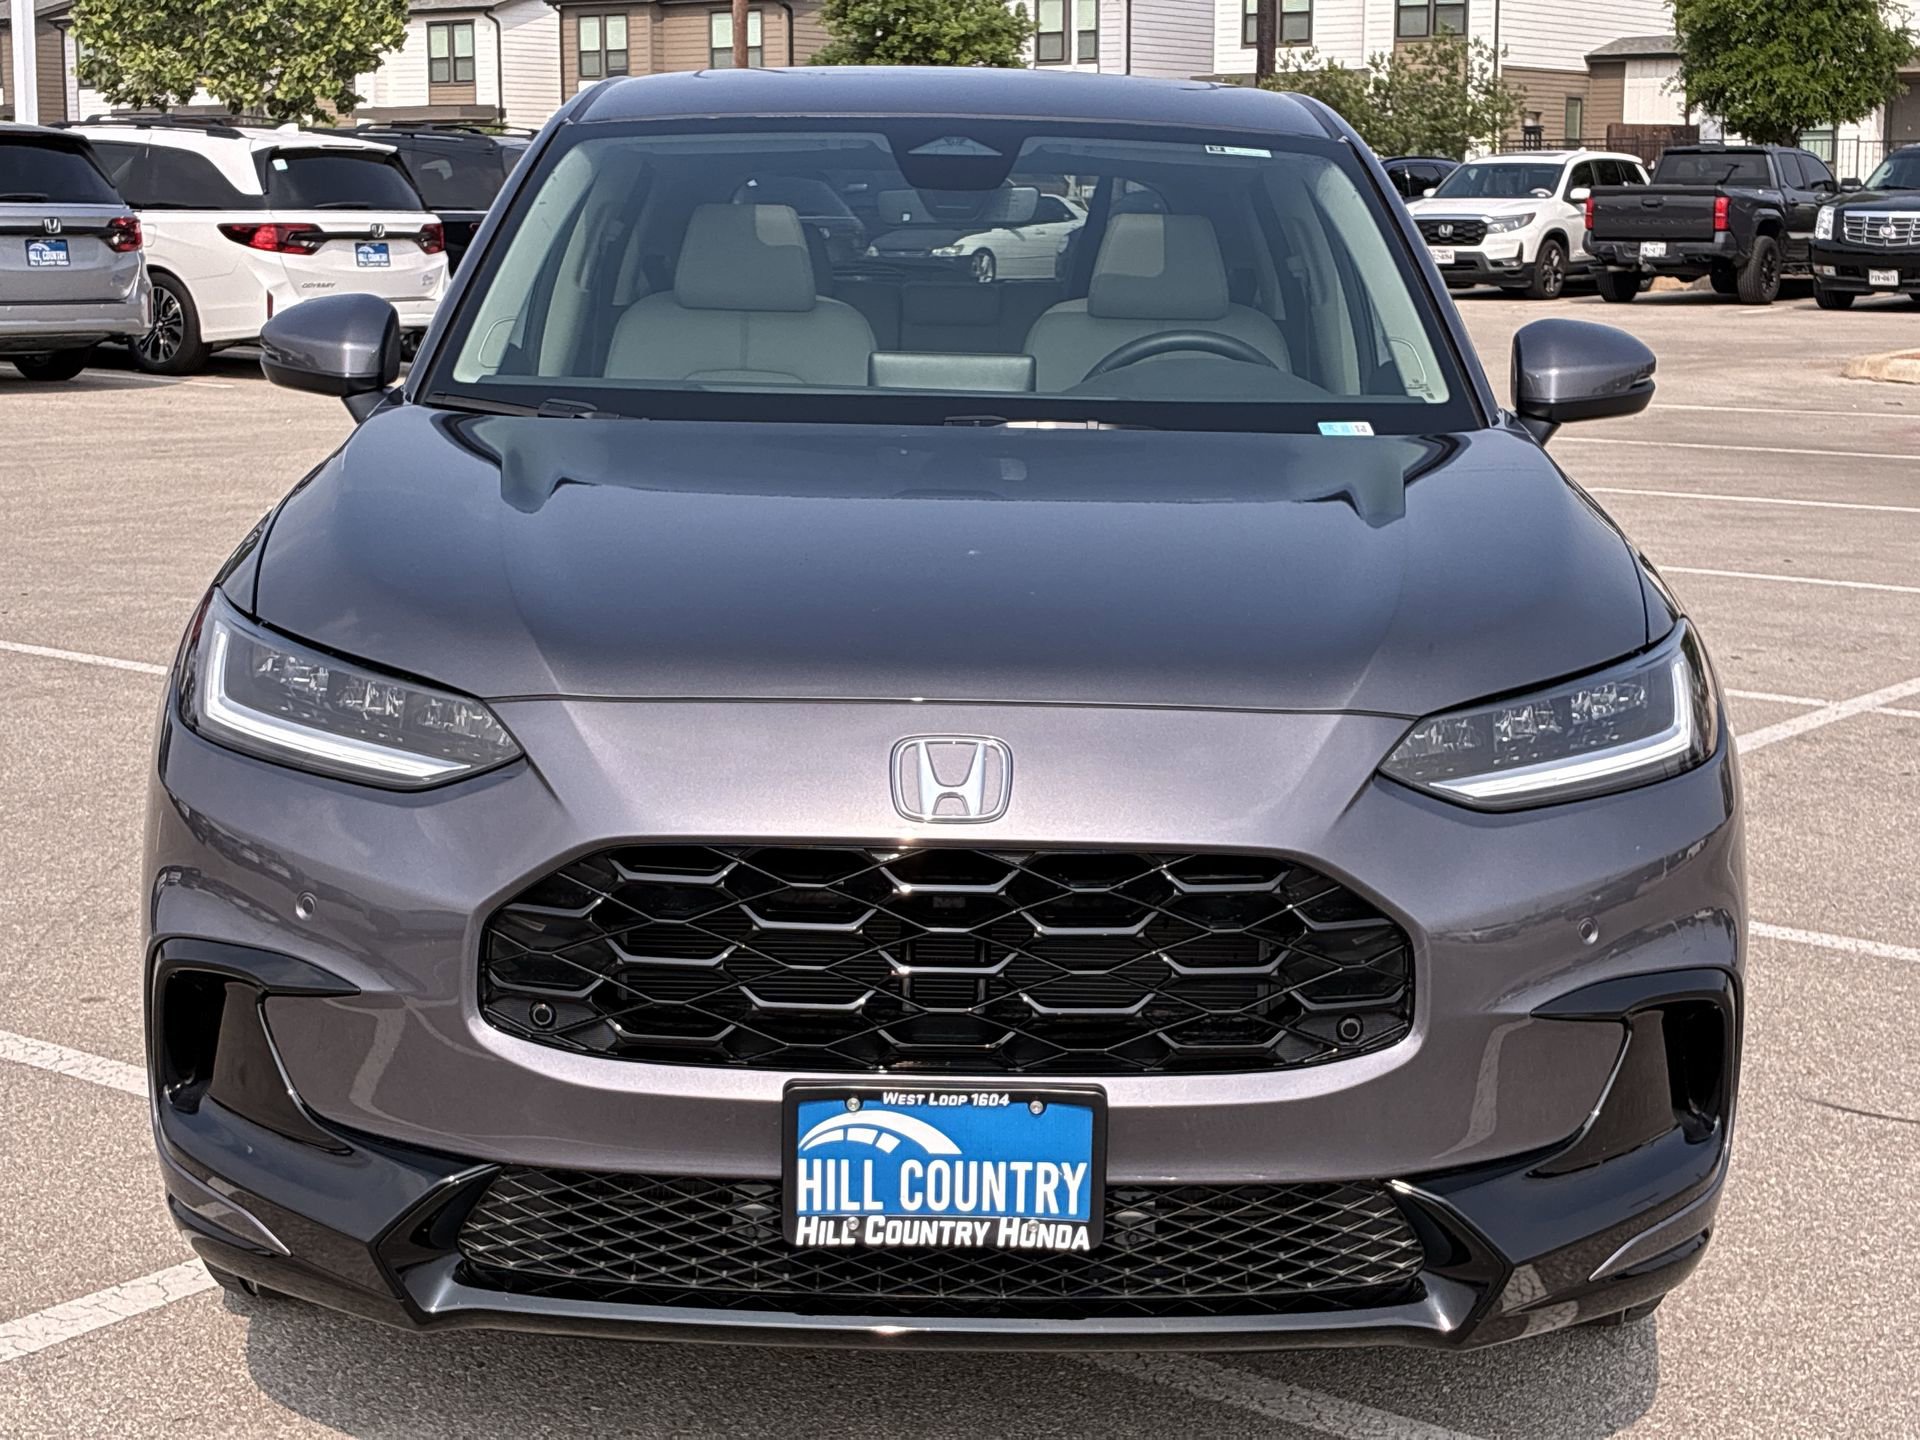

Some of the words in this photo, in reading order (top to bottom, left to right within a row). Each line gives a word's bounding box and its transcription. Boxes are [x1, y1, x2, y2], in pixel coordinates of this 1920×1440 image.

[970, 1093, 1010, 1107] 1604
[798, 1158, 884, 1212] HILL
[900, 1159, 1088, 1215] COUNTRY
